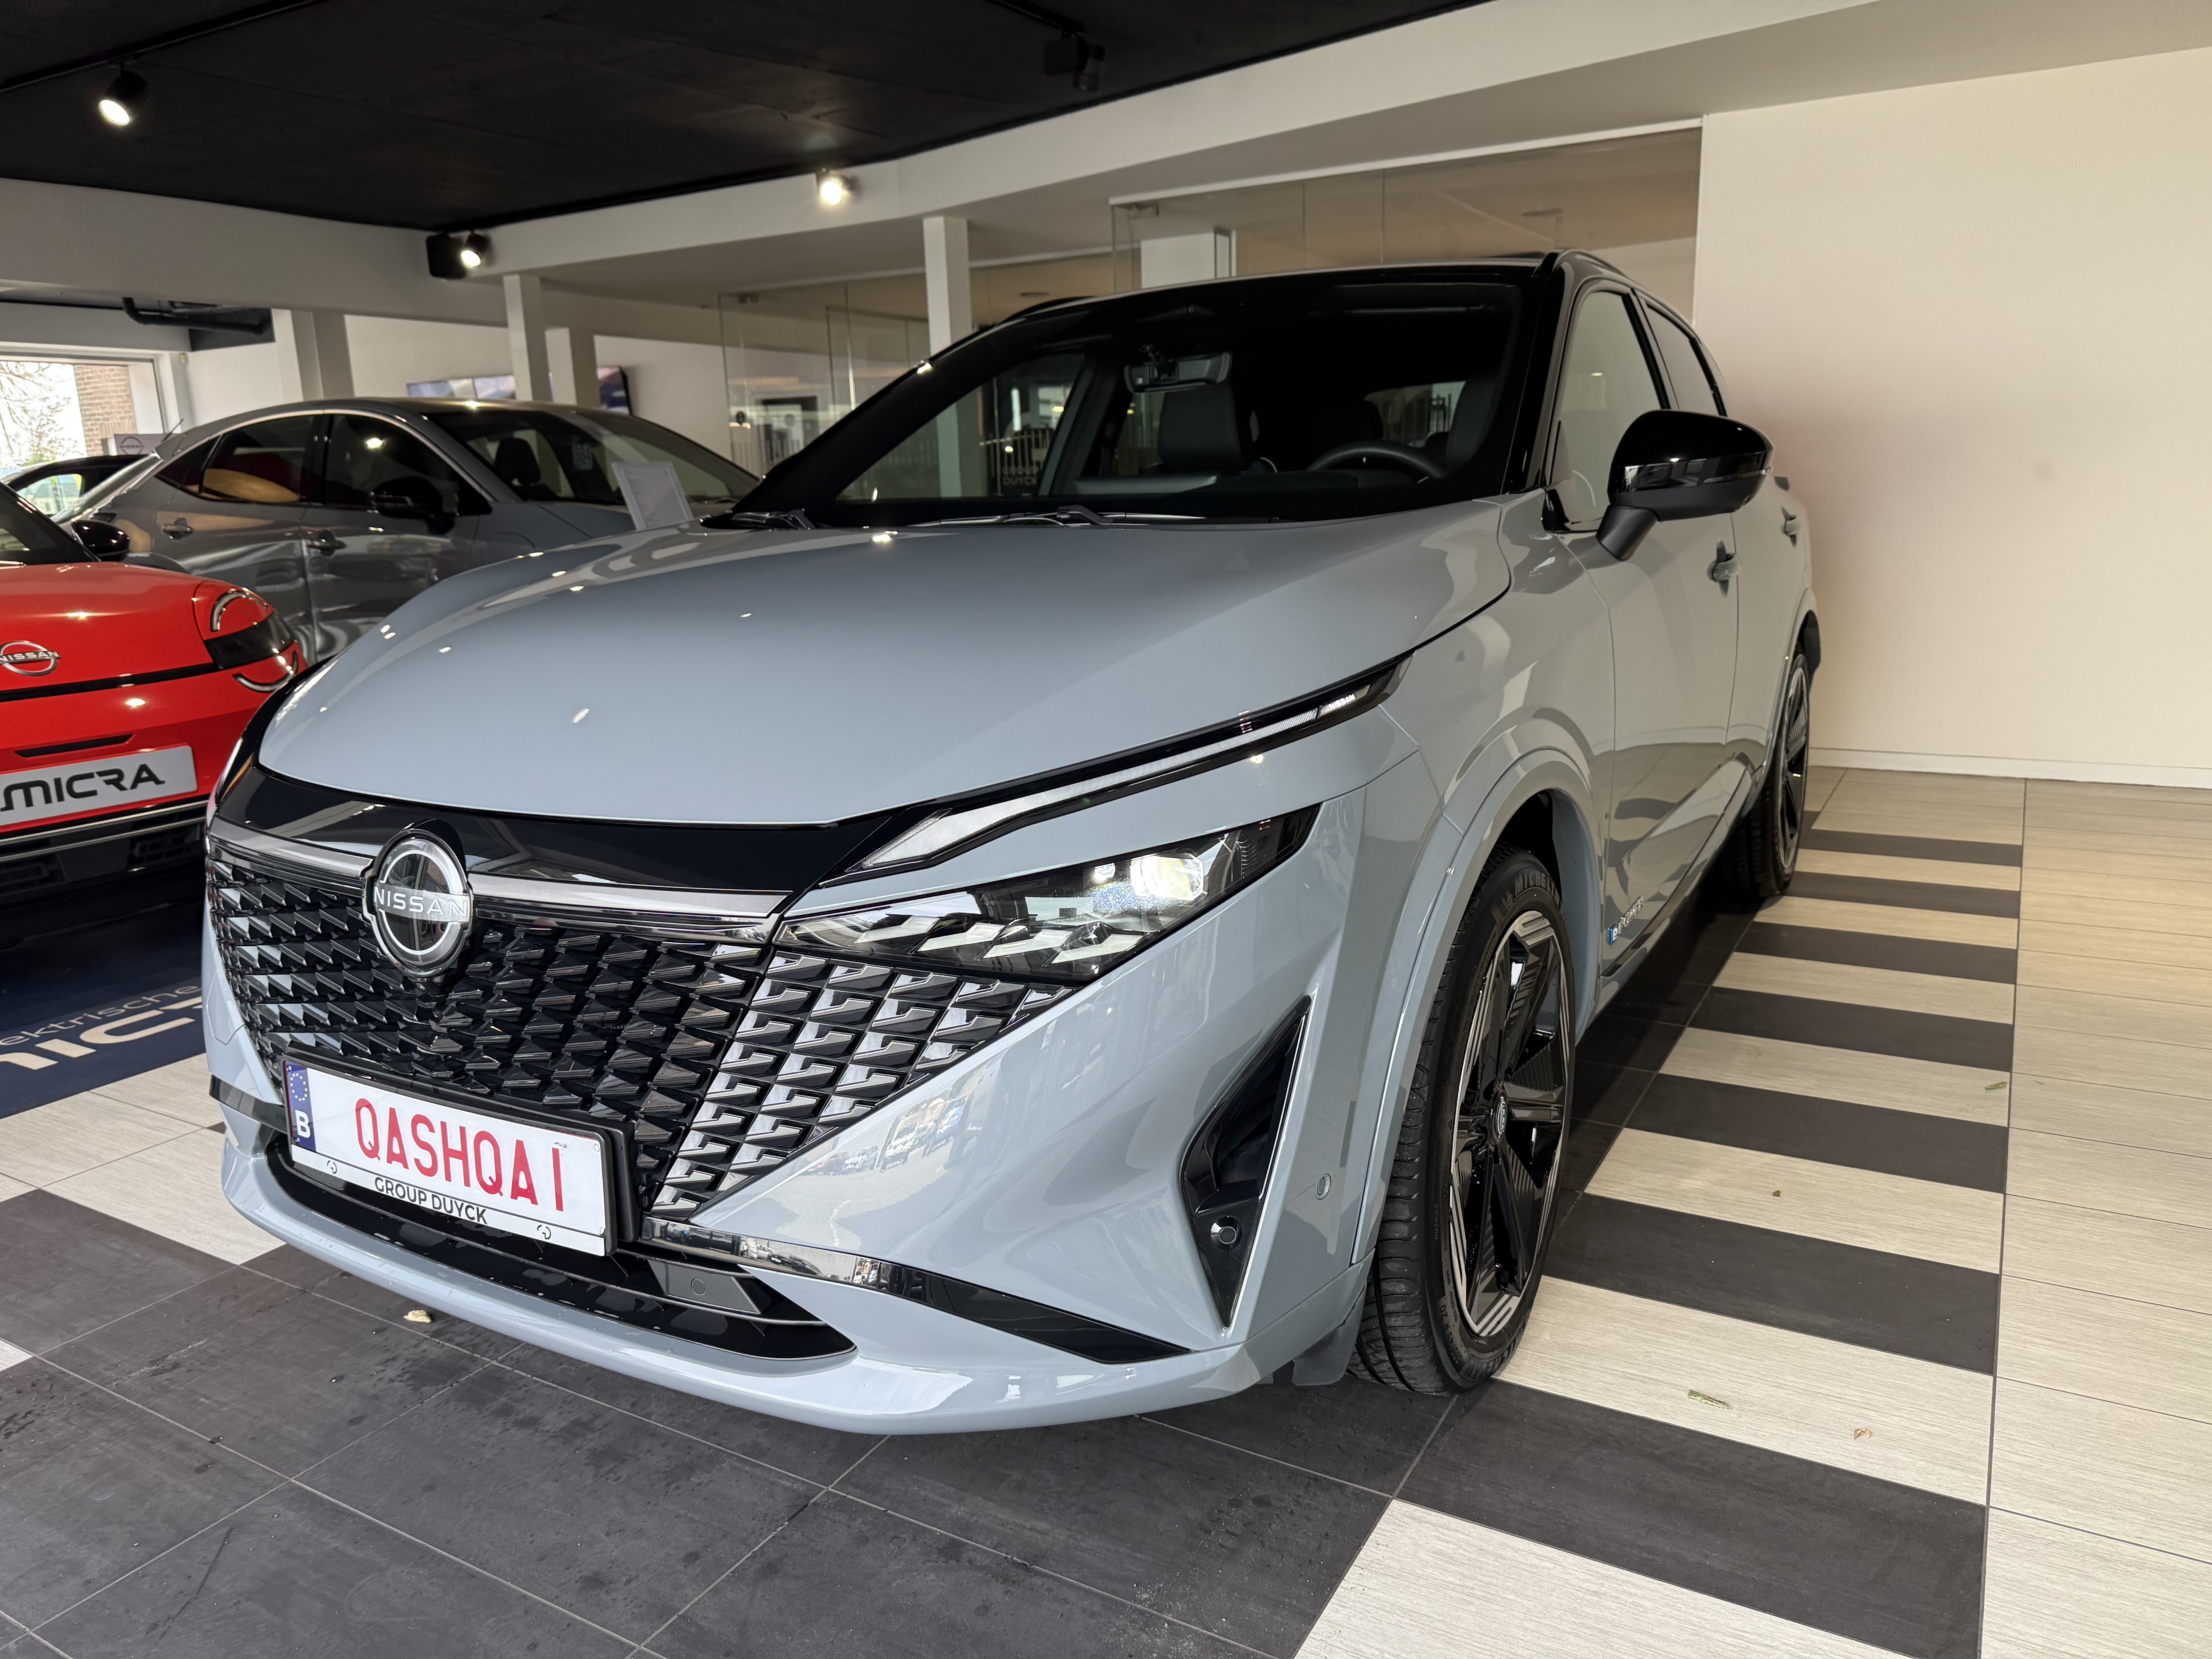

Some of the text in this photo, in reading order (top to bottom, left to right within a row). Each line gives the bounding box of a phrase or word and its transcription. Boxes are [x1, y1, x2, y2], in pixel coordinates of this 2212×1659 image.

[0, 651, 59, 661] NISSAN
[0, 764, 165, 812] MICRA
[374, 886, 468, 918] NISSAN
[1514, 870, 1561, 910] MICHELIN
[295, 1110, 311, 1139] B
[355, 1098, 564, 1211] QASHQAI
[375, 1177, 488, 1225] GROUP DUYCK
[1439, 1304, 1448, 1320] 20
